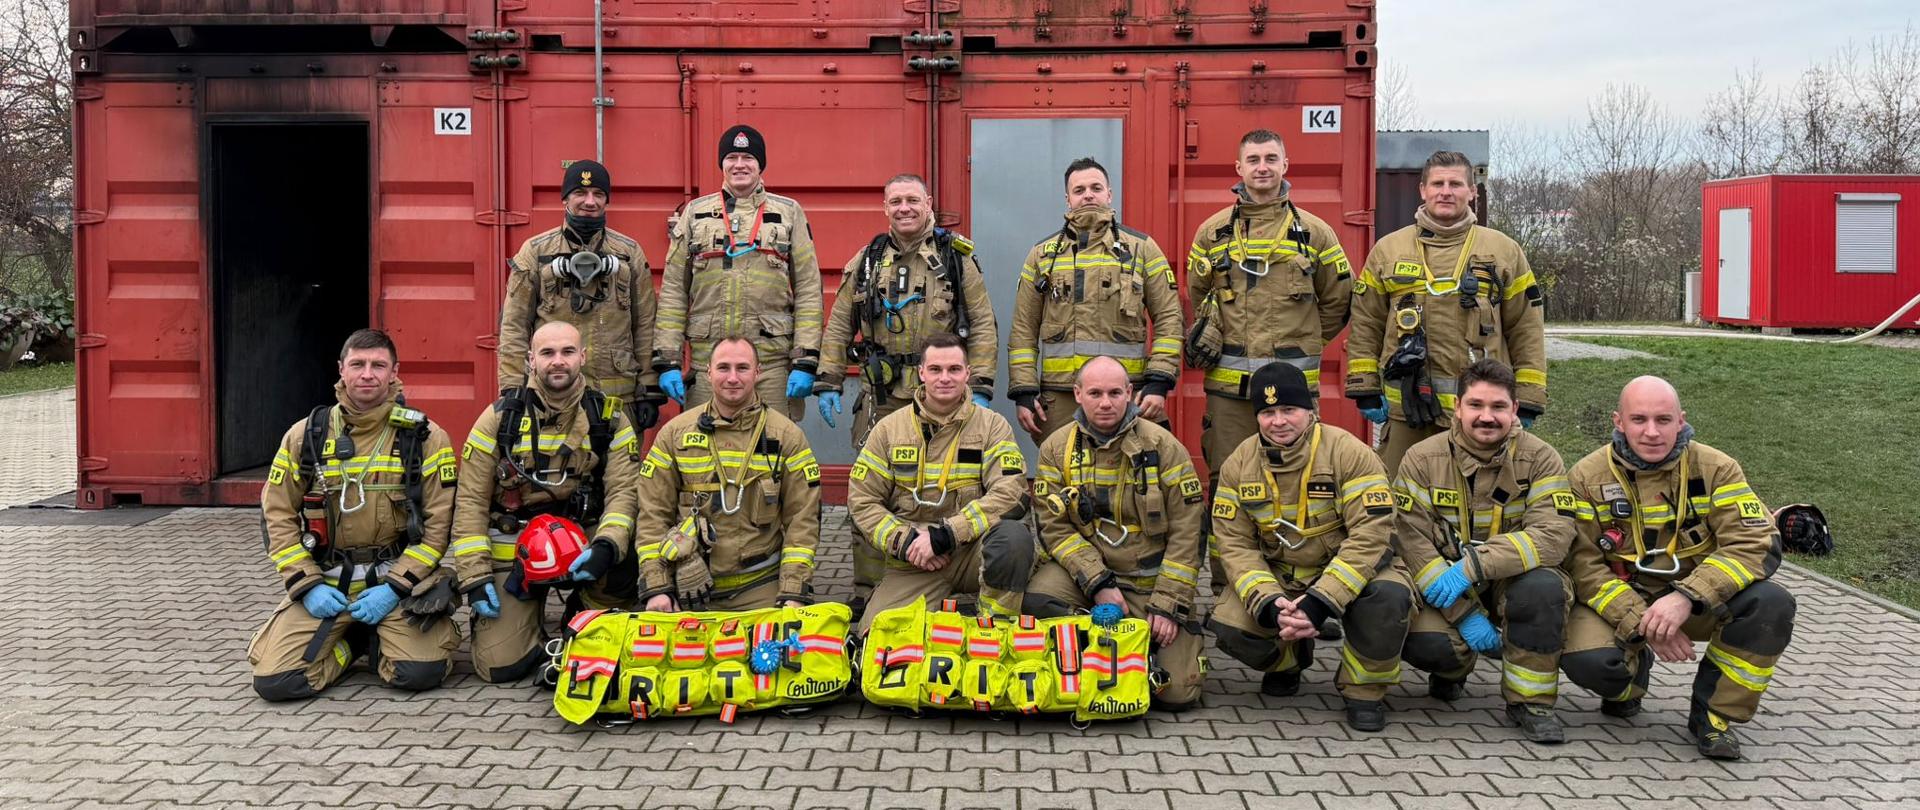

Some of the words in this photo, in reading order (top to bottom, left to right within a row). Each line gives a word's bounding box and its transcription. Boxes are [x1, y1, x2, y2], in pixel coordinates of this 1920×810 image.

[440, 112, 466, 130] K2
[1309, 110, 1336, 128] K4
[1399, 264, 1418, 272] PSP
[685, 434, 706, 444] PSP
[895, 449, 915, 459] PSP
[1003, 456, 1021, 465] PSP
[270, 469, 281, 480] SP
[1184, 480, 1200, 493] PSP
[1241, 486, 1262, 497] PSP
[1366, 492, 1388, 503] PSP
[1557, 495, 1573, 506] PSP
[1213, 503, 1232, 514] PSP
[1742, 502, 1760, 514] PSP
[928, 656, 1037, 702] RIT
[631, 671, 742, 704] RIT
[786, 676, 842, 697] Courant
